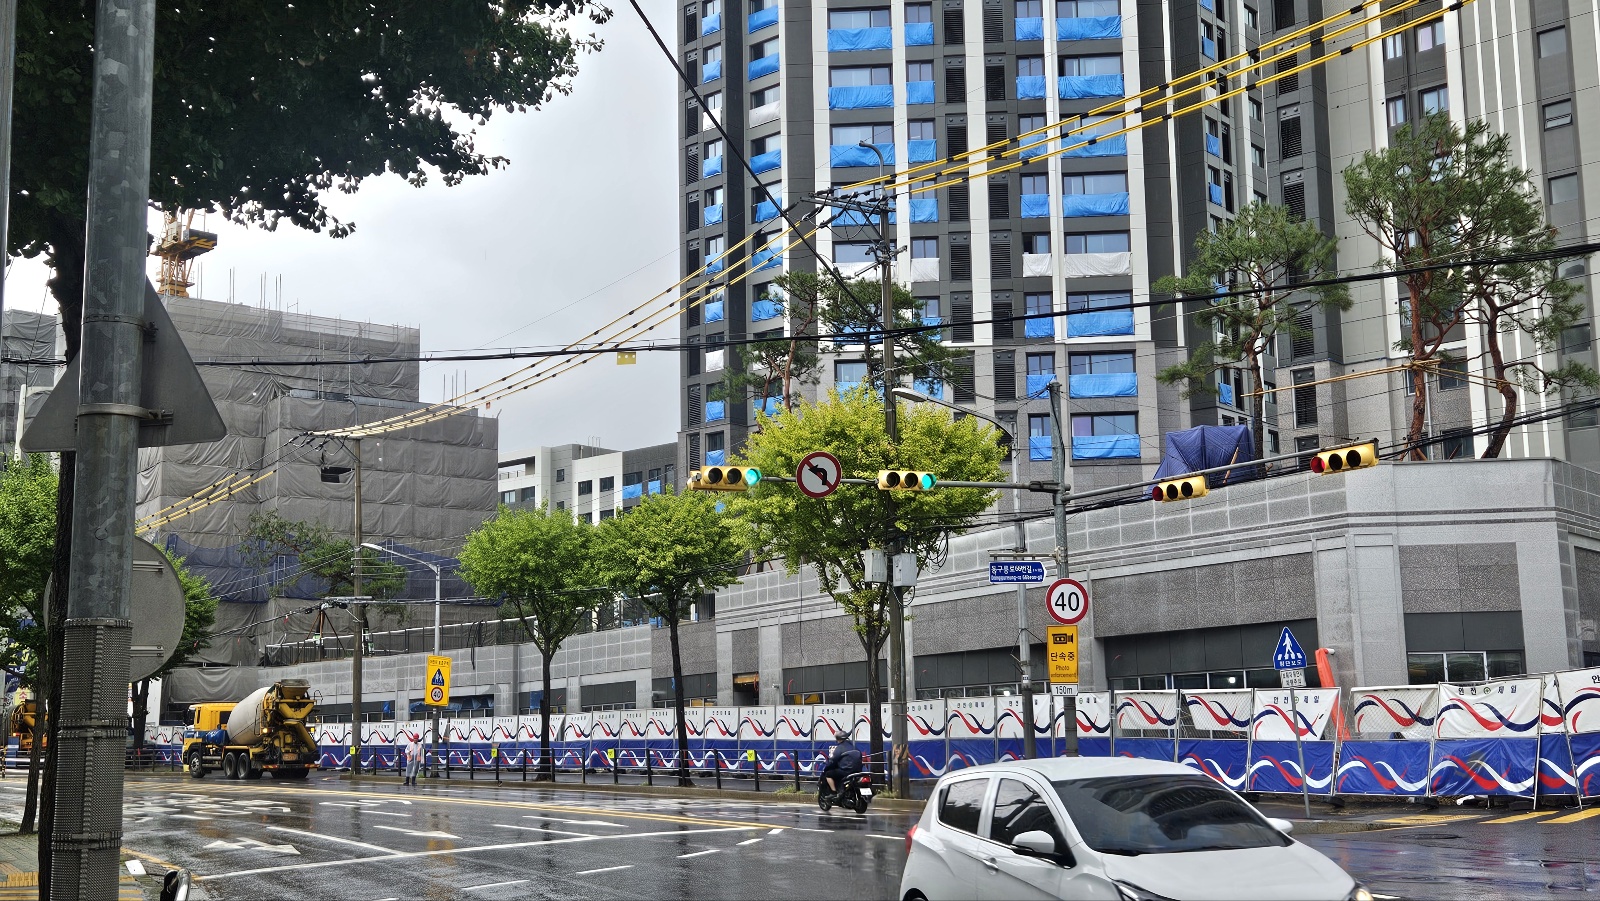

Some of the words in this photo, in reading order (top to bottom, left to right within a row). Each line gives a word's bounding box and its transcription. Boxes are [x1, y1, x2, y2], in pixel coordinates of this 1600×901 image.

[1054, 591, 1080, 612] 40
[1050, 651, 1075, 662] 단속중
[1050, 671, 1077, 679] enforcement
[433, 690, 441, 699] 40
[1055, 685, 1073, 695] 150m
